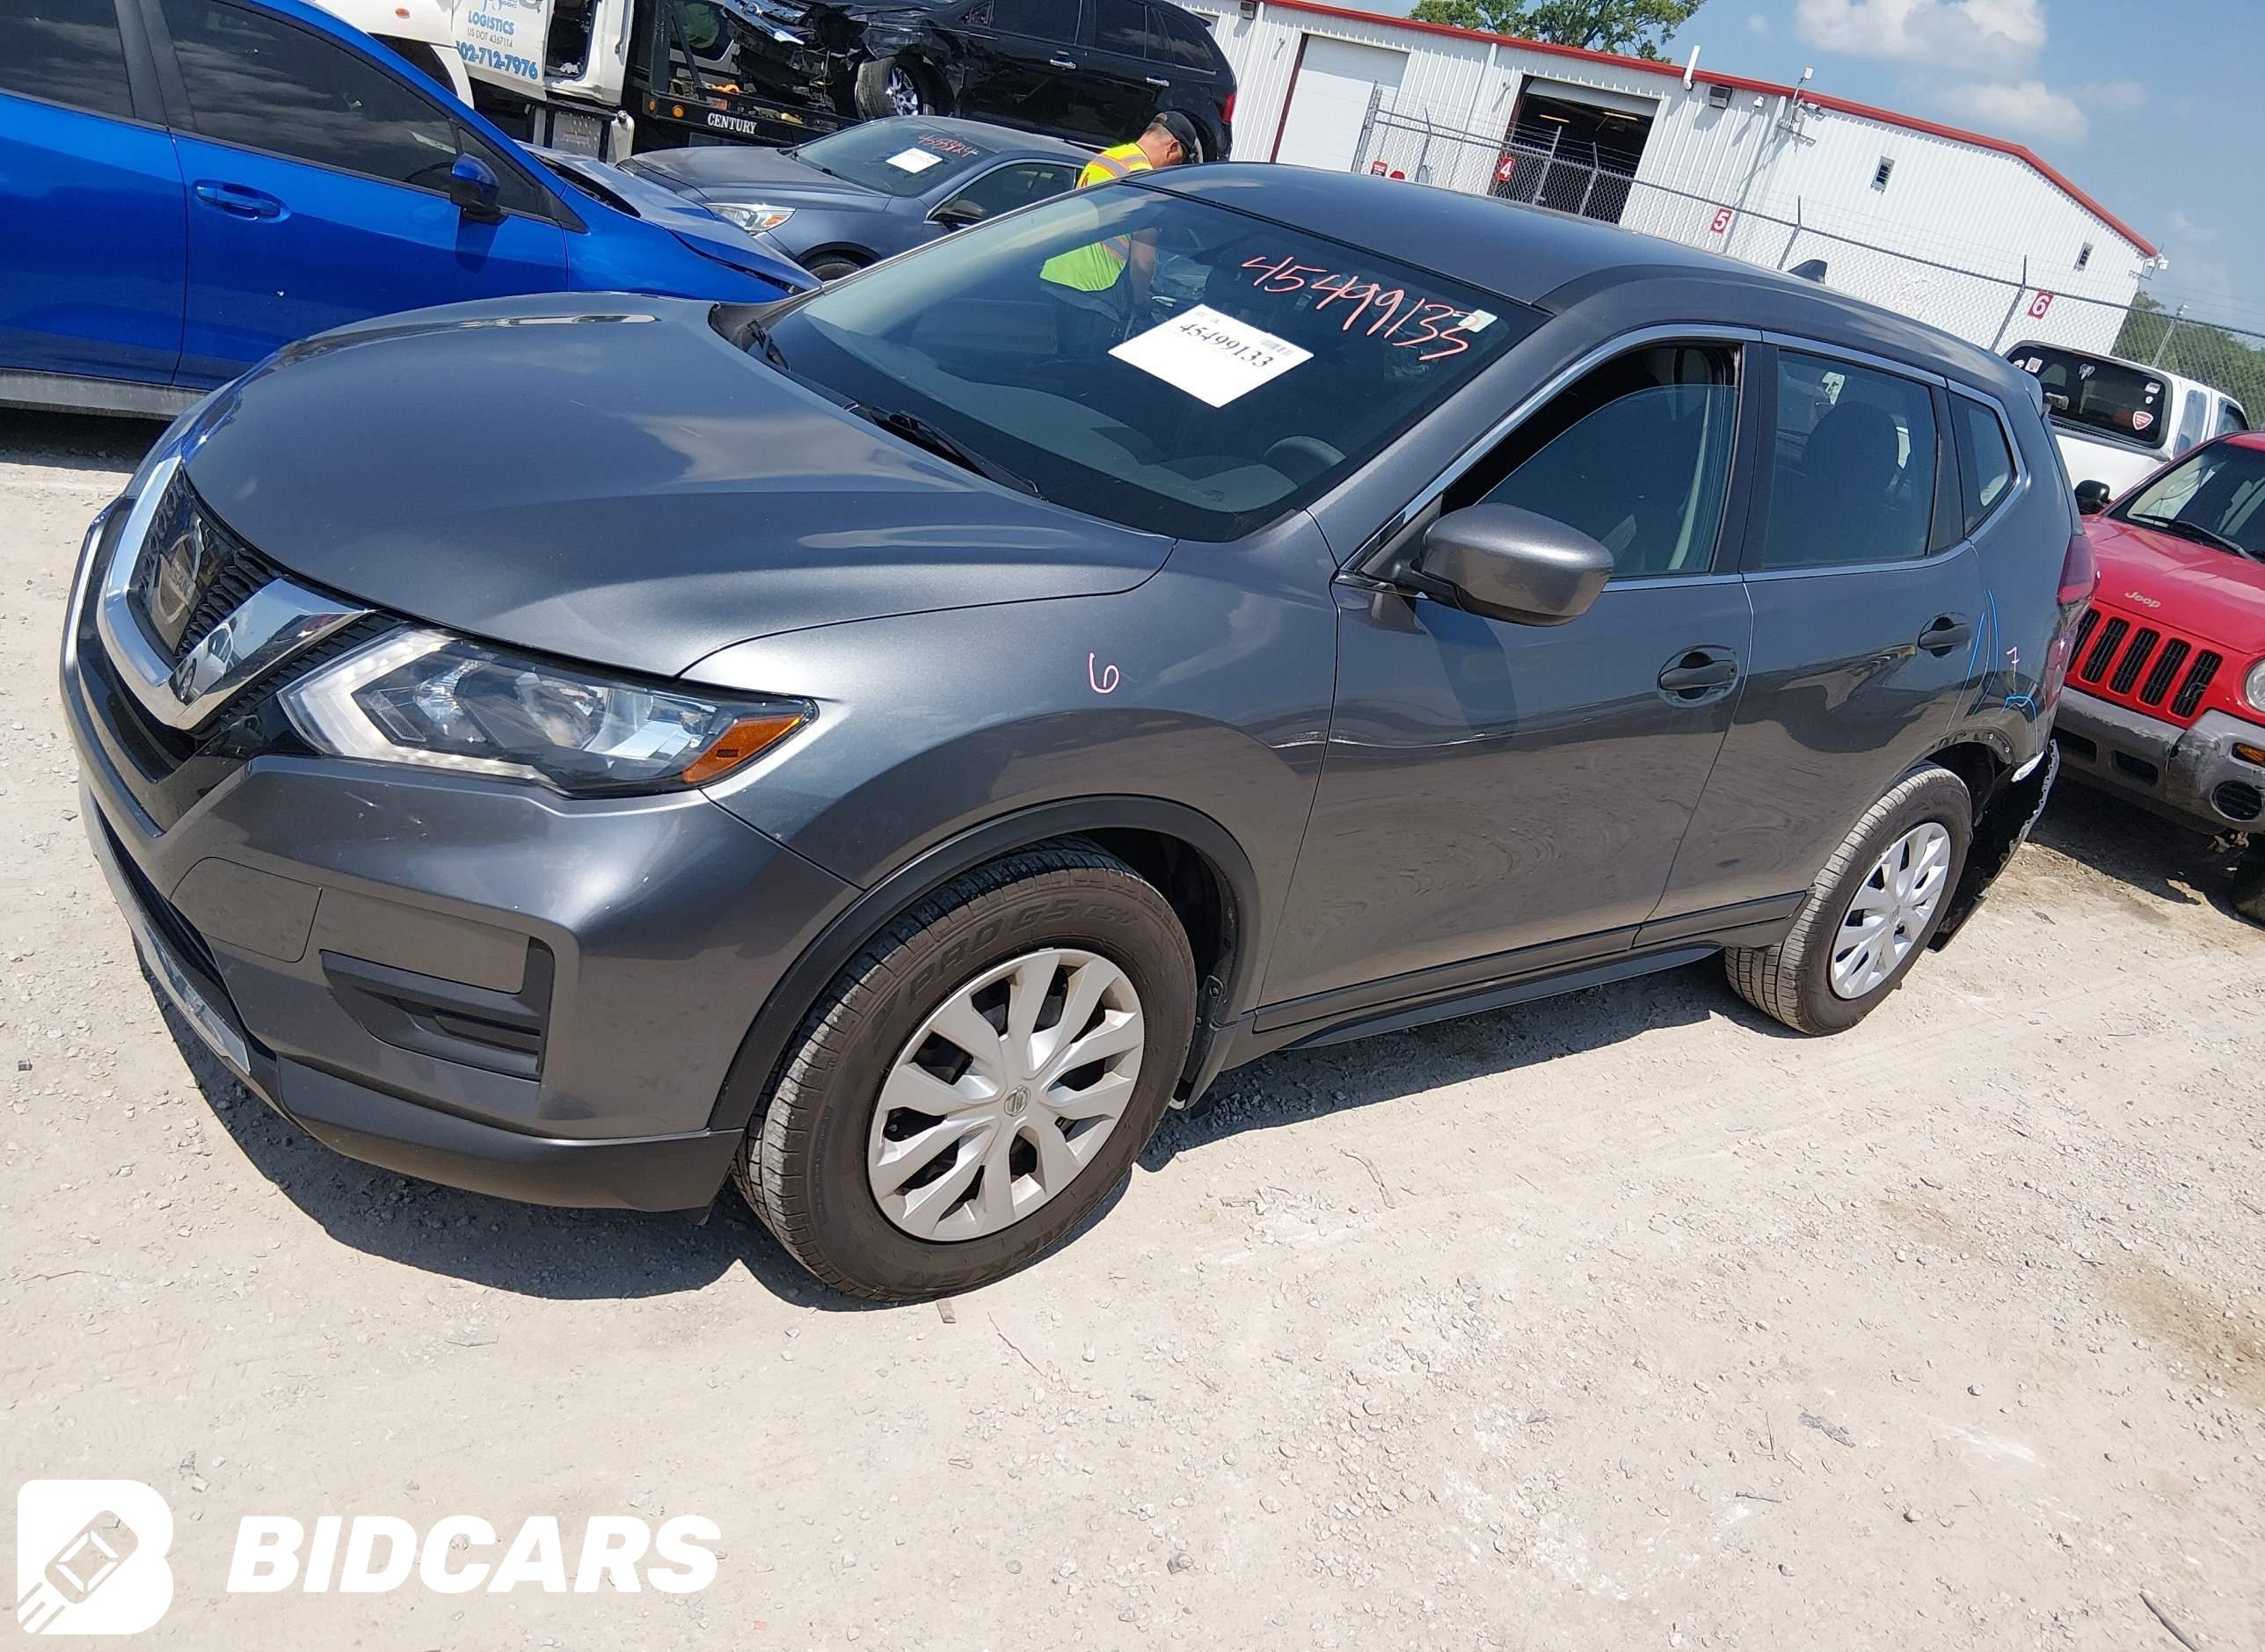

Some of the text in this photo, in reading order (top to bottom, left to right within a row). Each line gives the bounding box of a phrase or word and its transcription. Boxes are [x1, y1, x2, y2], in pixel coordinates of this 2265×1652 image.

[467, 27, 475, 37] US
[476, 30, 489, 40] DOT
[468, 10, 514, 35] LOGISTICS
[455, 40, 538, 80] 02-712-7976
[707, 112, 757, 135] CENTURY
[1499, 160, 1512, 178] 4
[1714, 211, 1730, 230] 5
[1241, 256, 1480, 361] 45499133
[2032, 295, 2050, 316] 6
[1179, 323, 1273, 368] 45499133
[2123, 591, 2162, 608] Jeep
[1089, 651, 1119, 694] 6
